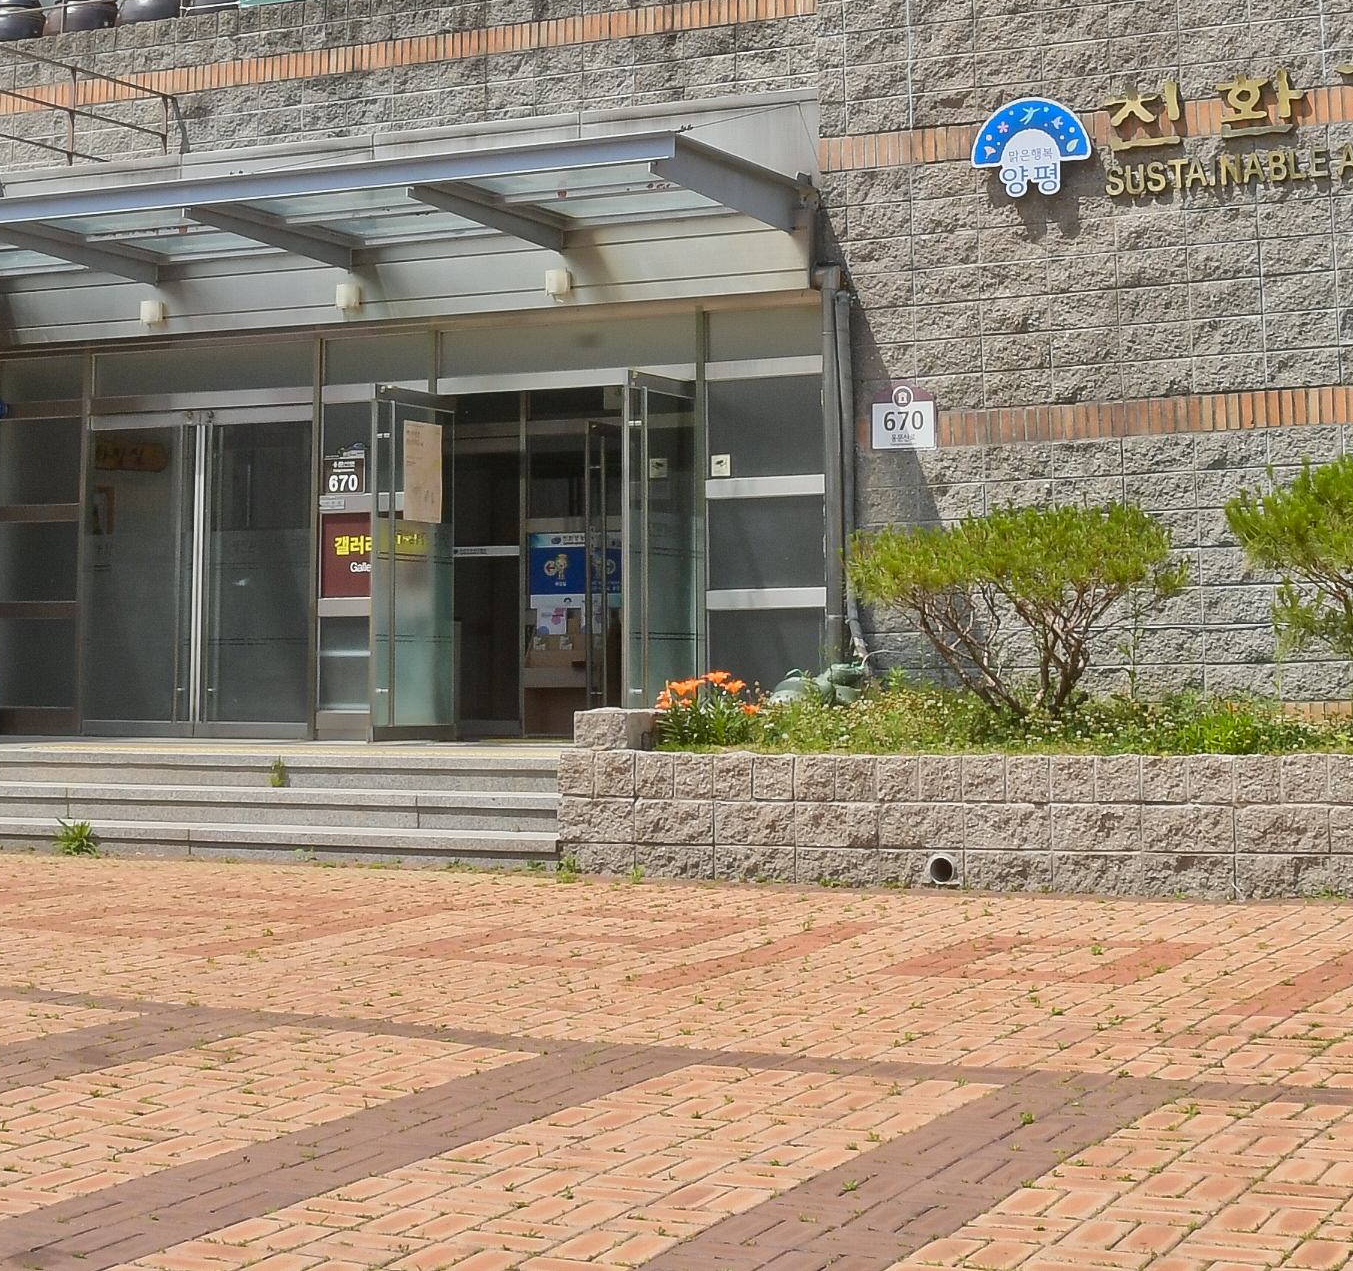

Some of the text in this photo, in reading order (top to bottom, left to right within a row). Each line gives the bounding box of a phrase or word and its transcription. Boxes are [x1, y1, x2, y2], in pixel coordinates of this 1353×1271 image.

[1002, 163, 1057, 194] 양평
[1105, 146, 1330, 197] SUSTAINABLE
[883, 410, 924, 431] 670
[328, 474, 358, 492] 670
